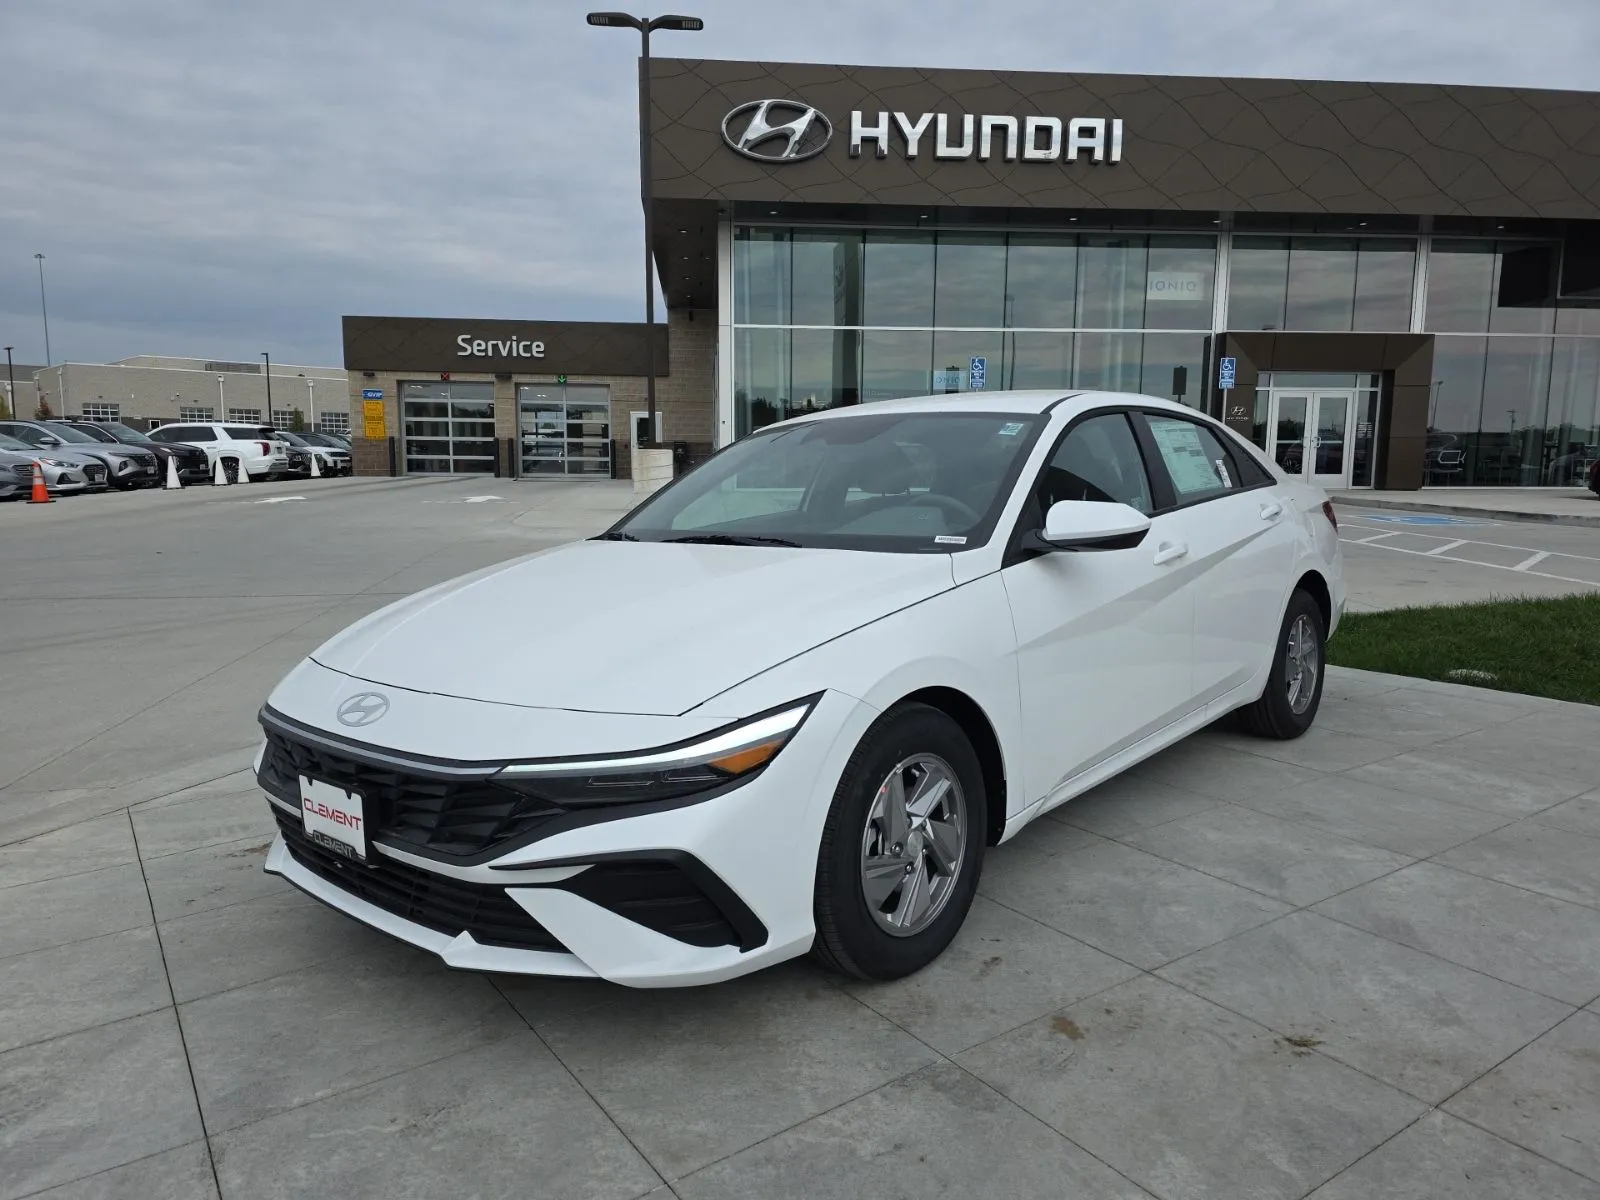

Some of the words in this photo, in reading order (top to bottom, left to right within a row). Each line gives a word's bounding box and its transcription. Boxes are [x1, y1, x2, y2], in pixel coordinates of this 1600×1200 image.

[850, 110, 1123, 164] HYUNDAI
[457, 334, 545, 357] Service
[303, 797, 362, 830] CLEMENT
[314, 832, 352, 858] CLEMENT
